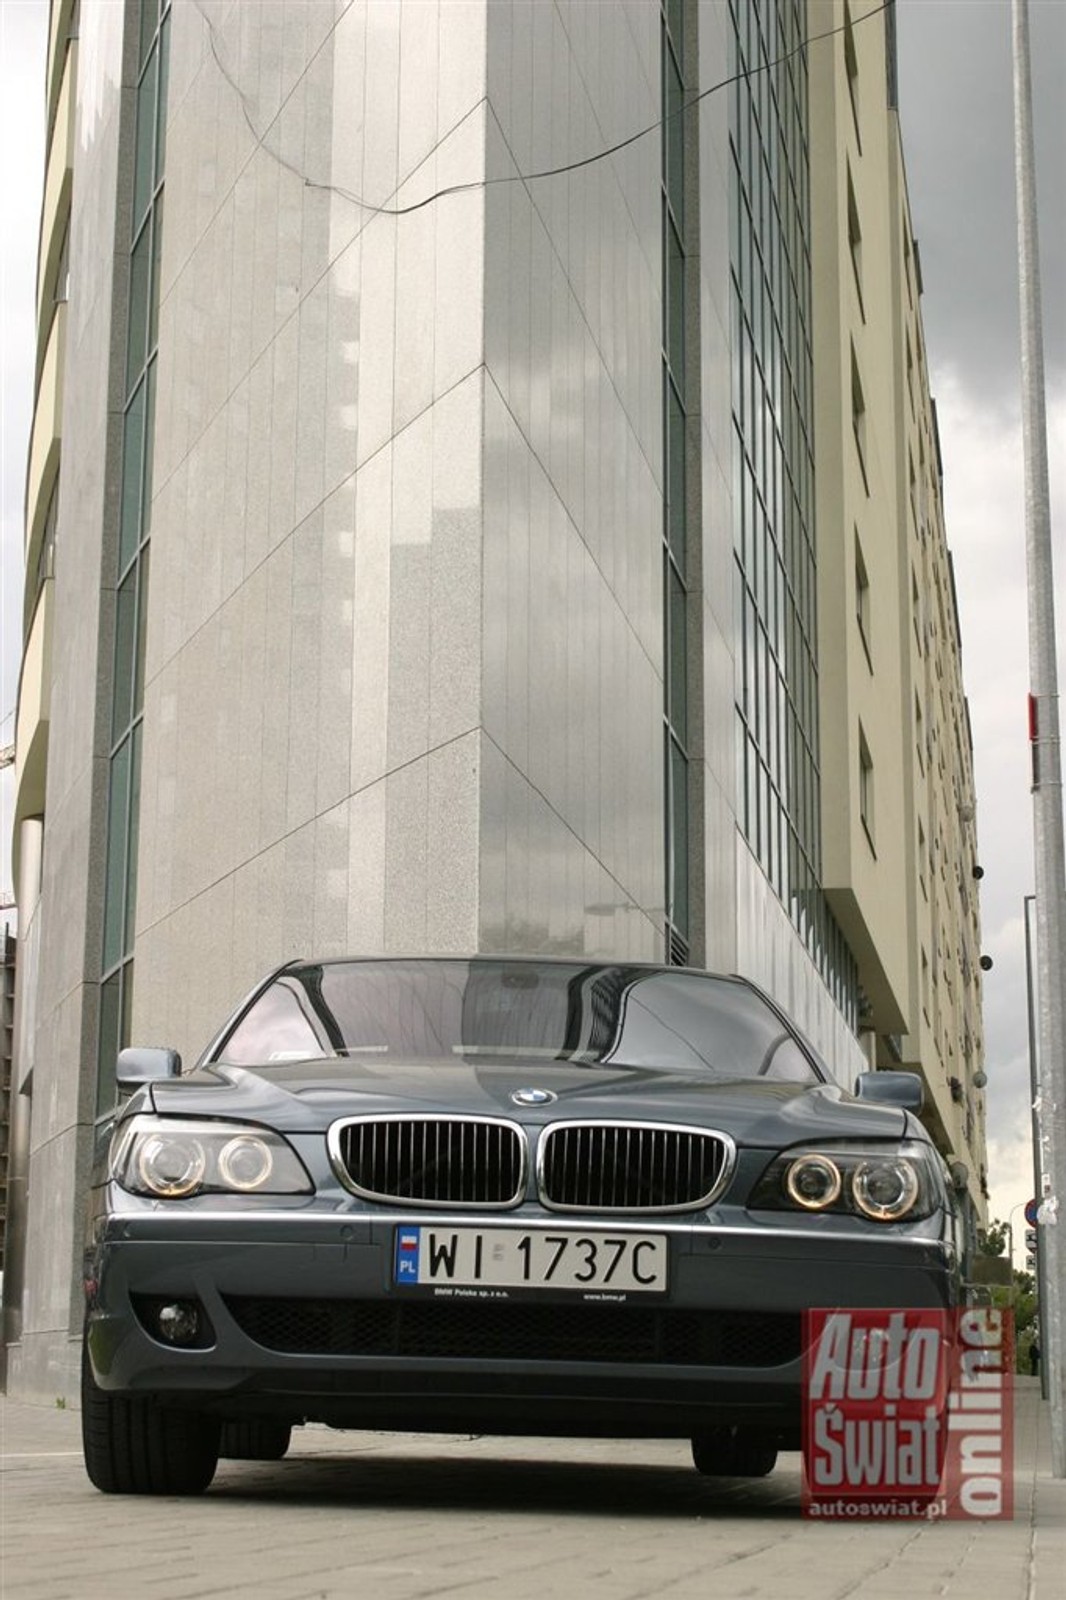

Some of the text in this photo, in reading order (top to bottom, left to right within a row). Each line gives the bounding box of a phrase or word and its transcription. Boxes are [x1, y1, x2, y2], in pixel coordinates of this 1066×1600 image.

[400, 1260, 416, 1273] PL
[429, 1233, 657, 1284] WI 1737C
